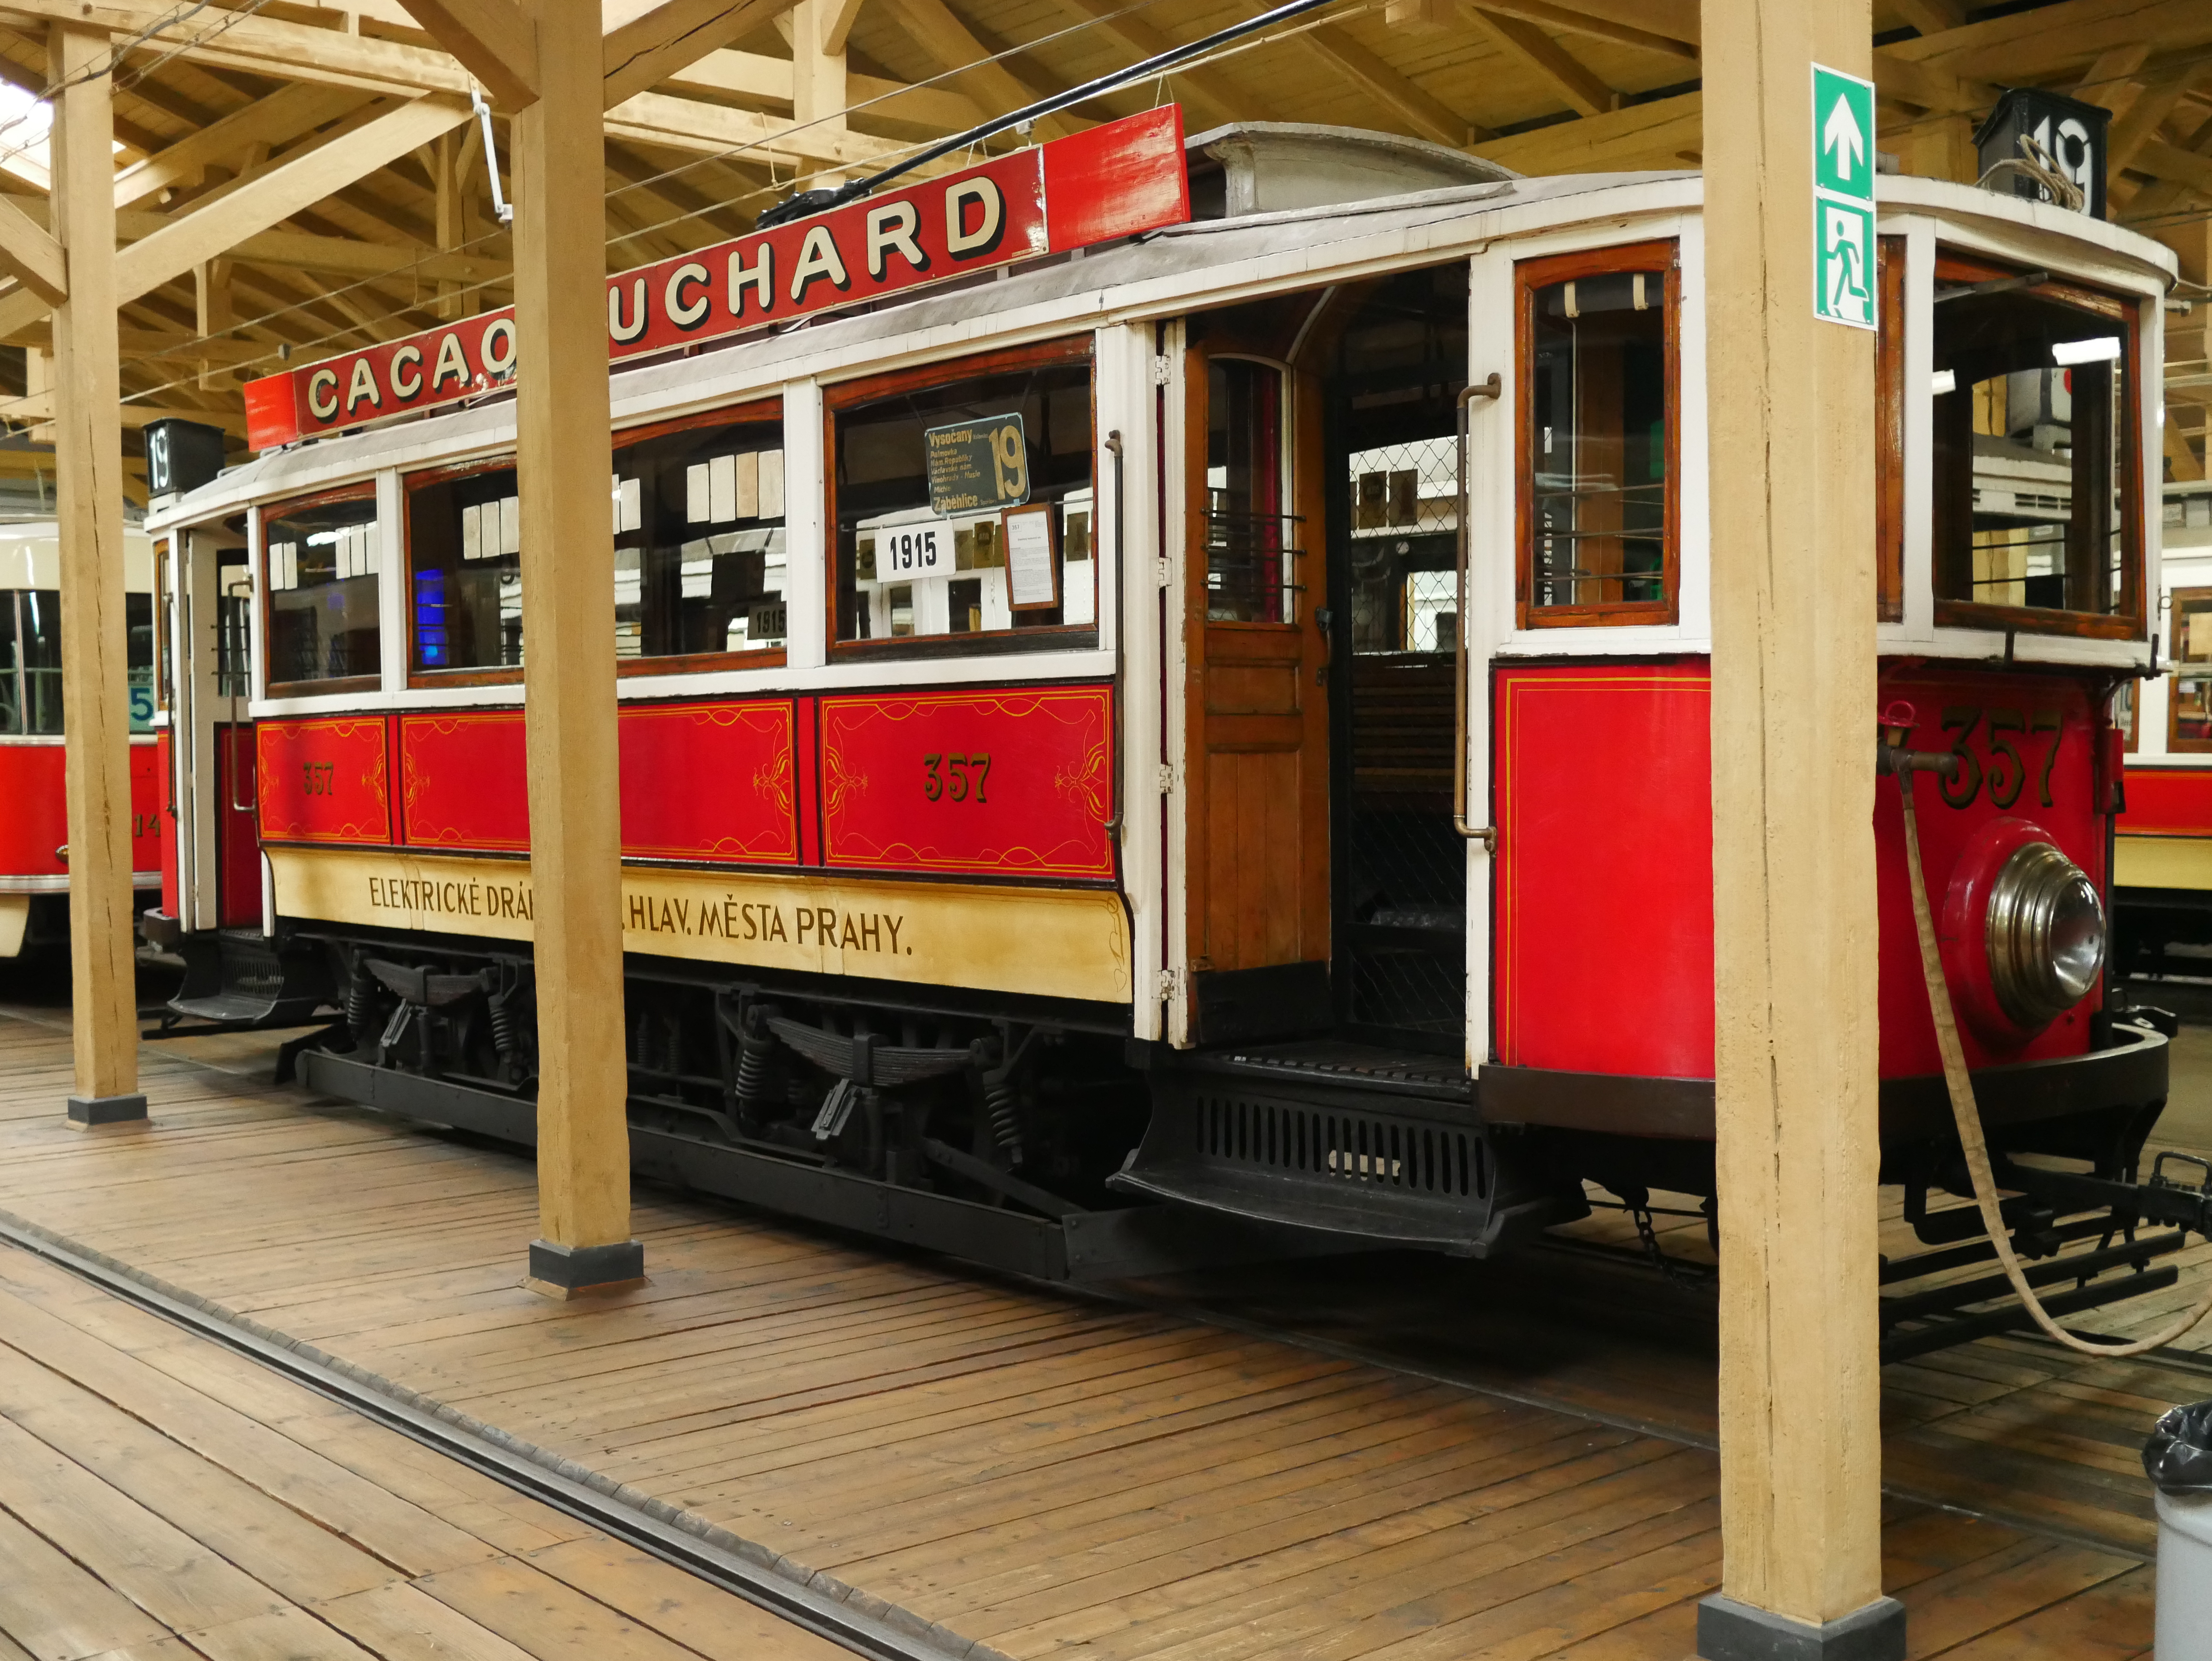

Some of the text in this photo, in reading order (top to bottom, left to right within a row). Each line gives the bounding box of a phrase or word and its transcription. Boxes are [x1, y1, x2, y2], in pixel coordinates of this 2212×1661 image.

[2034, 115, 2093, 216] 19
[308, 176, 1004, 421] CACAO UCHARD
[929, 428, 973, 448] Vysočany
[930, 448, 957, 459] Palmovka
[150, 427, 169, 489] 19
[989, 425, 1026, 500] 19
[932, 474, 959, 484] Vinohrady
[934, 493, 978, 512] Záběhlice
[890, 531, 936, 570] 1915
[757, 609, 785, 633] 1915
[131, 687, 153, 721] 5
[1938, 705, 2063, 805] 357
[303, 762, 333, 796] 357
[924, 752, 991, 804] 357
[369, 877, 912, 956] ELEKTRICKÉ DRÁ HLAV. MĚSTA PRAHY.
